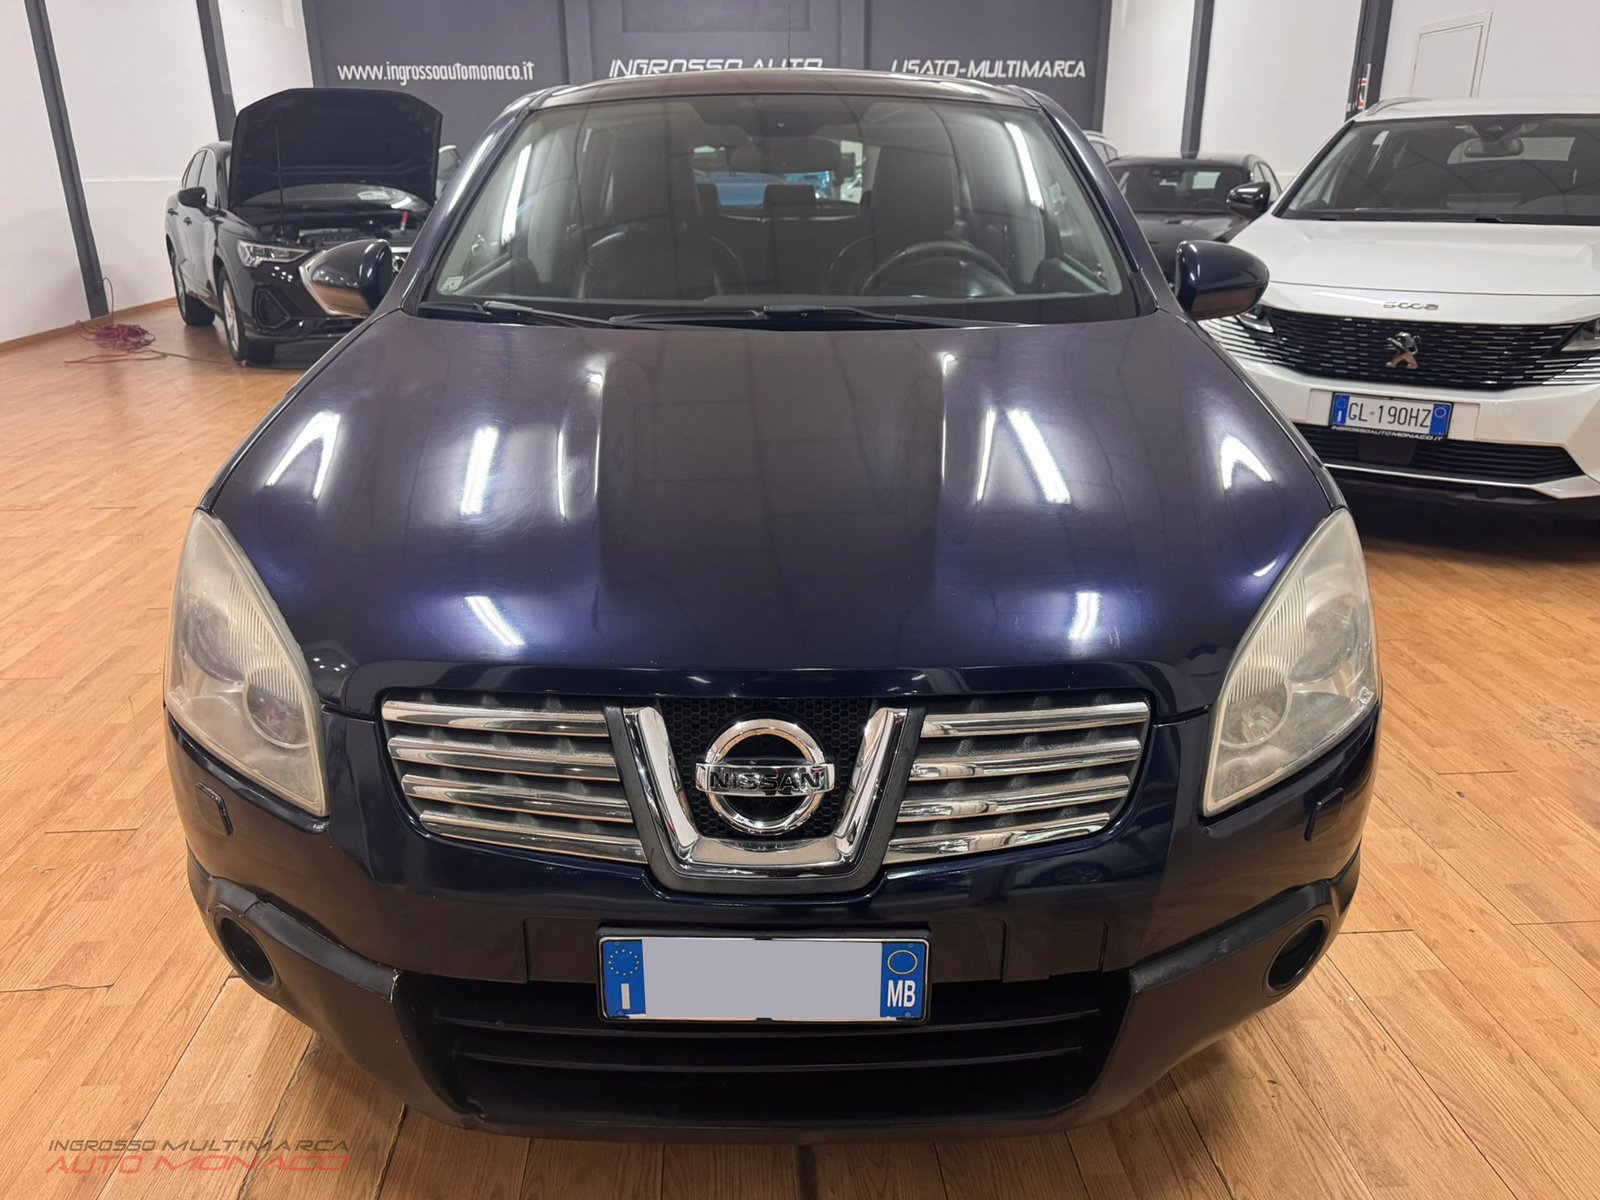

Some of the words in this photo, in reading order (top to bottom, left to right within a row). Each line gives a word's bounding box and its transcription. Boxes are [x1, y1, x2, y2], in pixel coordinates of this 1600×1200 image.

[337, 61, 535, 86] www.ingrossoautomonaco.it
[608, 59, 744, 78] INGROSSO
[891, 59, 1086, 78] USATO-MULTIMARCA
[709, 771, 827, 790] NISSAN
[886, 979, 916, 1008] MB
